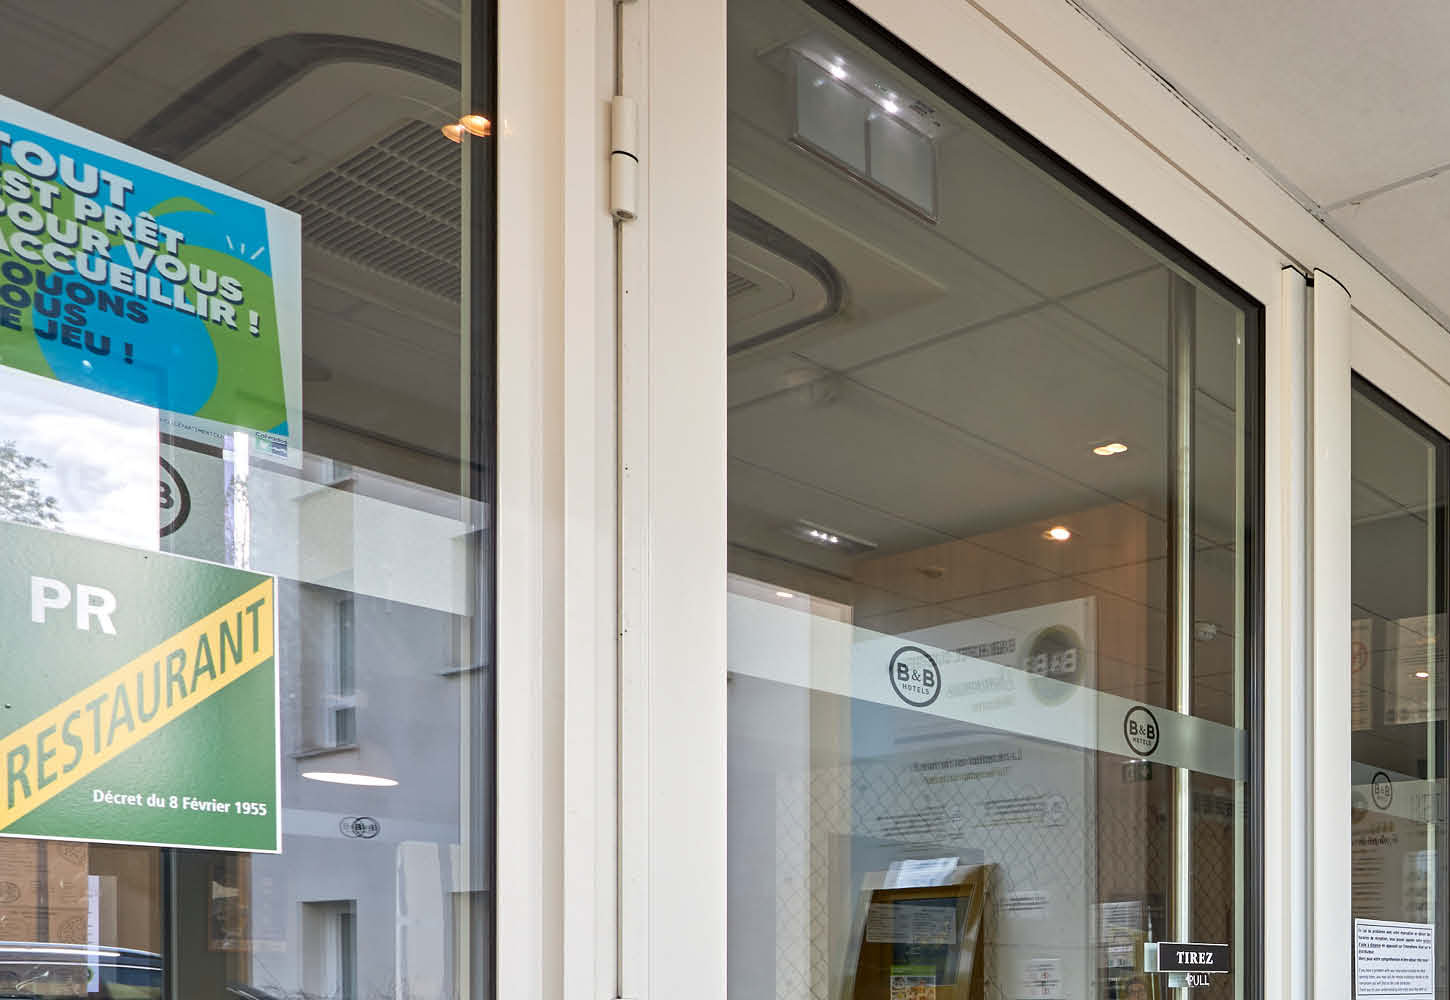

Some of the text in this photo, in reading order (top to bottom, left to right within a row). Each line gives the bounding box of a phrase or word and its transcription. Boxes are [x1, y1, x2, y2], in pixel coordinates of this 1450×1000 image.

[0, 170, 184, 256] ST PRÊT
[0, 200, 244, 305] OUR VOUS
[250, 310, 260, 337] !
[34, 319, 111, 356] JEU
[125, 343, 133, 364] !
[31, 576, 118, 635] PR
[897, 662, 934, 687] B&B
[902, 683, 929, 695] HOTELS
[6, 598, 266, 809] RESTAURANT
[1130, 720, 1155, 739] B&B
[92, 788, 267, 816] Décret du 8 Février 1955
[1177, 951, 1213, 964] TIREZ
[1188, 973, 1210, 986] PULL
